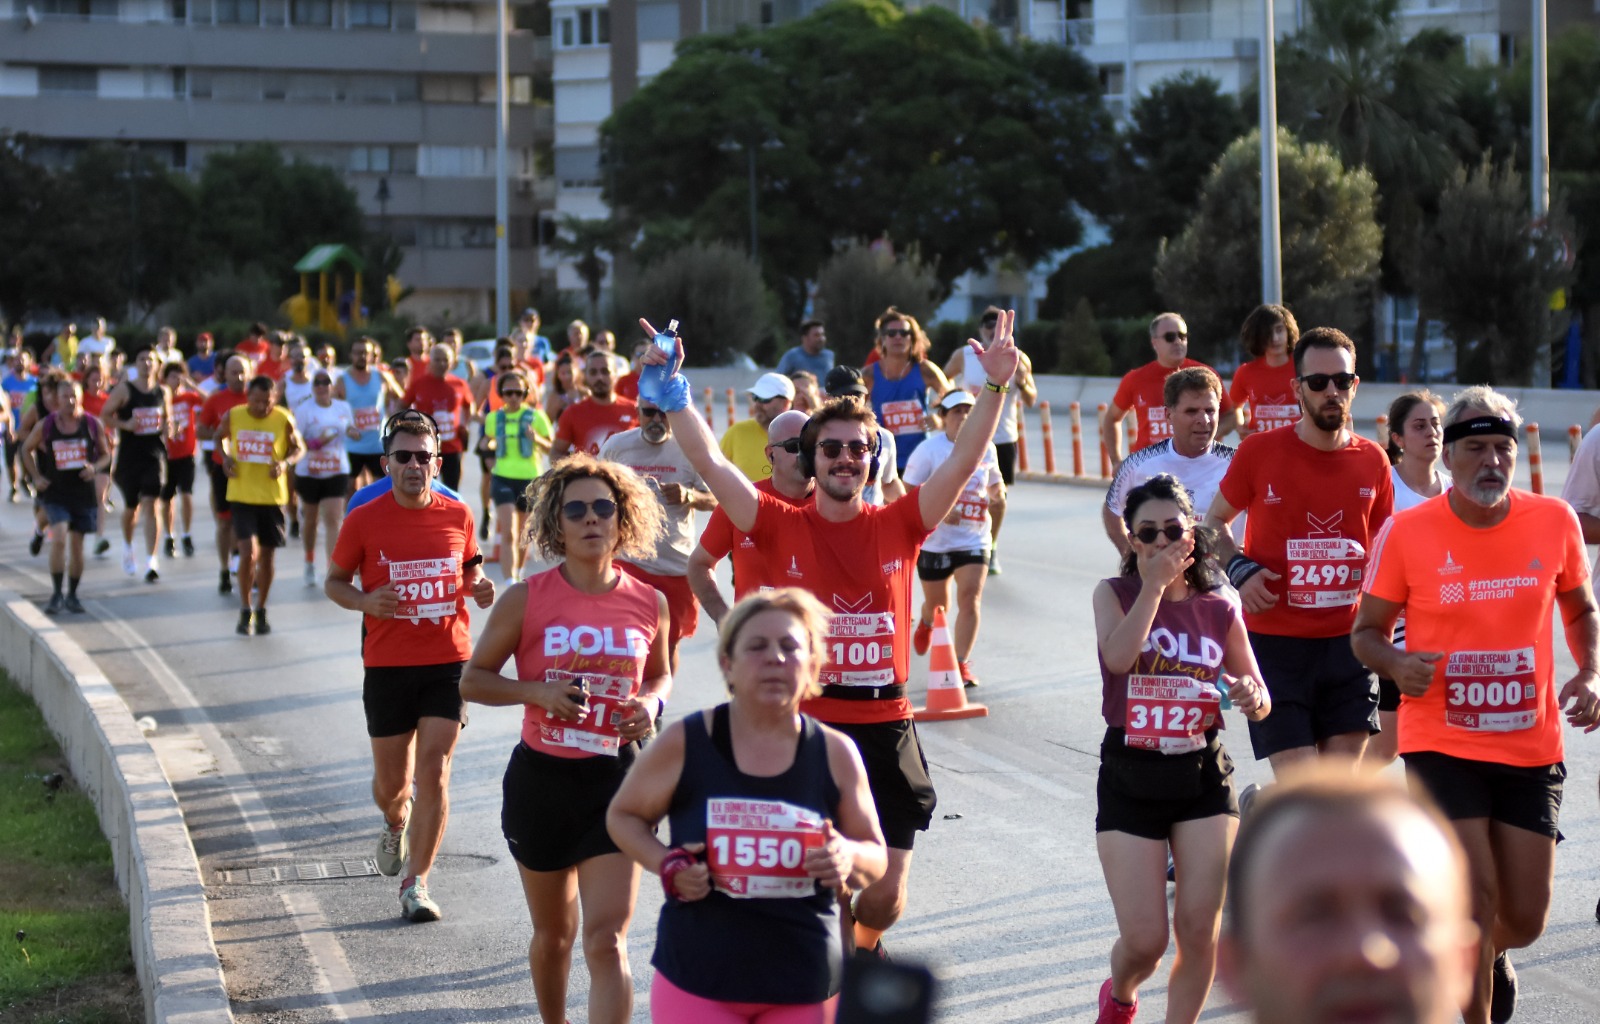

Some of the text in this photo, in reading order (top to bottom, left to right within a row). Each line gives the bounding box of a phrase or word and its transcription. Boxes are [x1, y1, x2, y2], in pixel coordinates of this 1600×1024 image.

[238, 442, 265, 453] 1962
[1290, 564, 1350, 586] 2499
[1468, 576, 1538, 590] #maraton
[394, 580, 444, 600] 2901
[544, 626, 649, 657] BOLD
[1141, 628, 1223, 668] OLD
[1162, 678, 1194, 688] HEYECANLA
[1448, 681, 1522, 706] 3000
[1130, 704, 1202, 730] 3122
[713, 835, 802, 869] 1550
